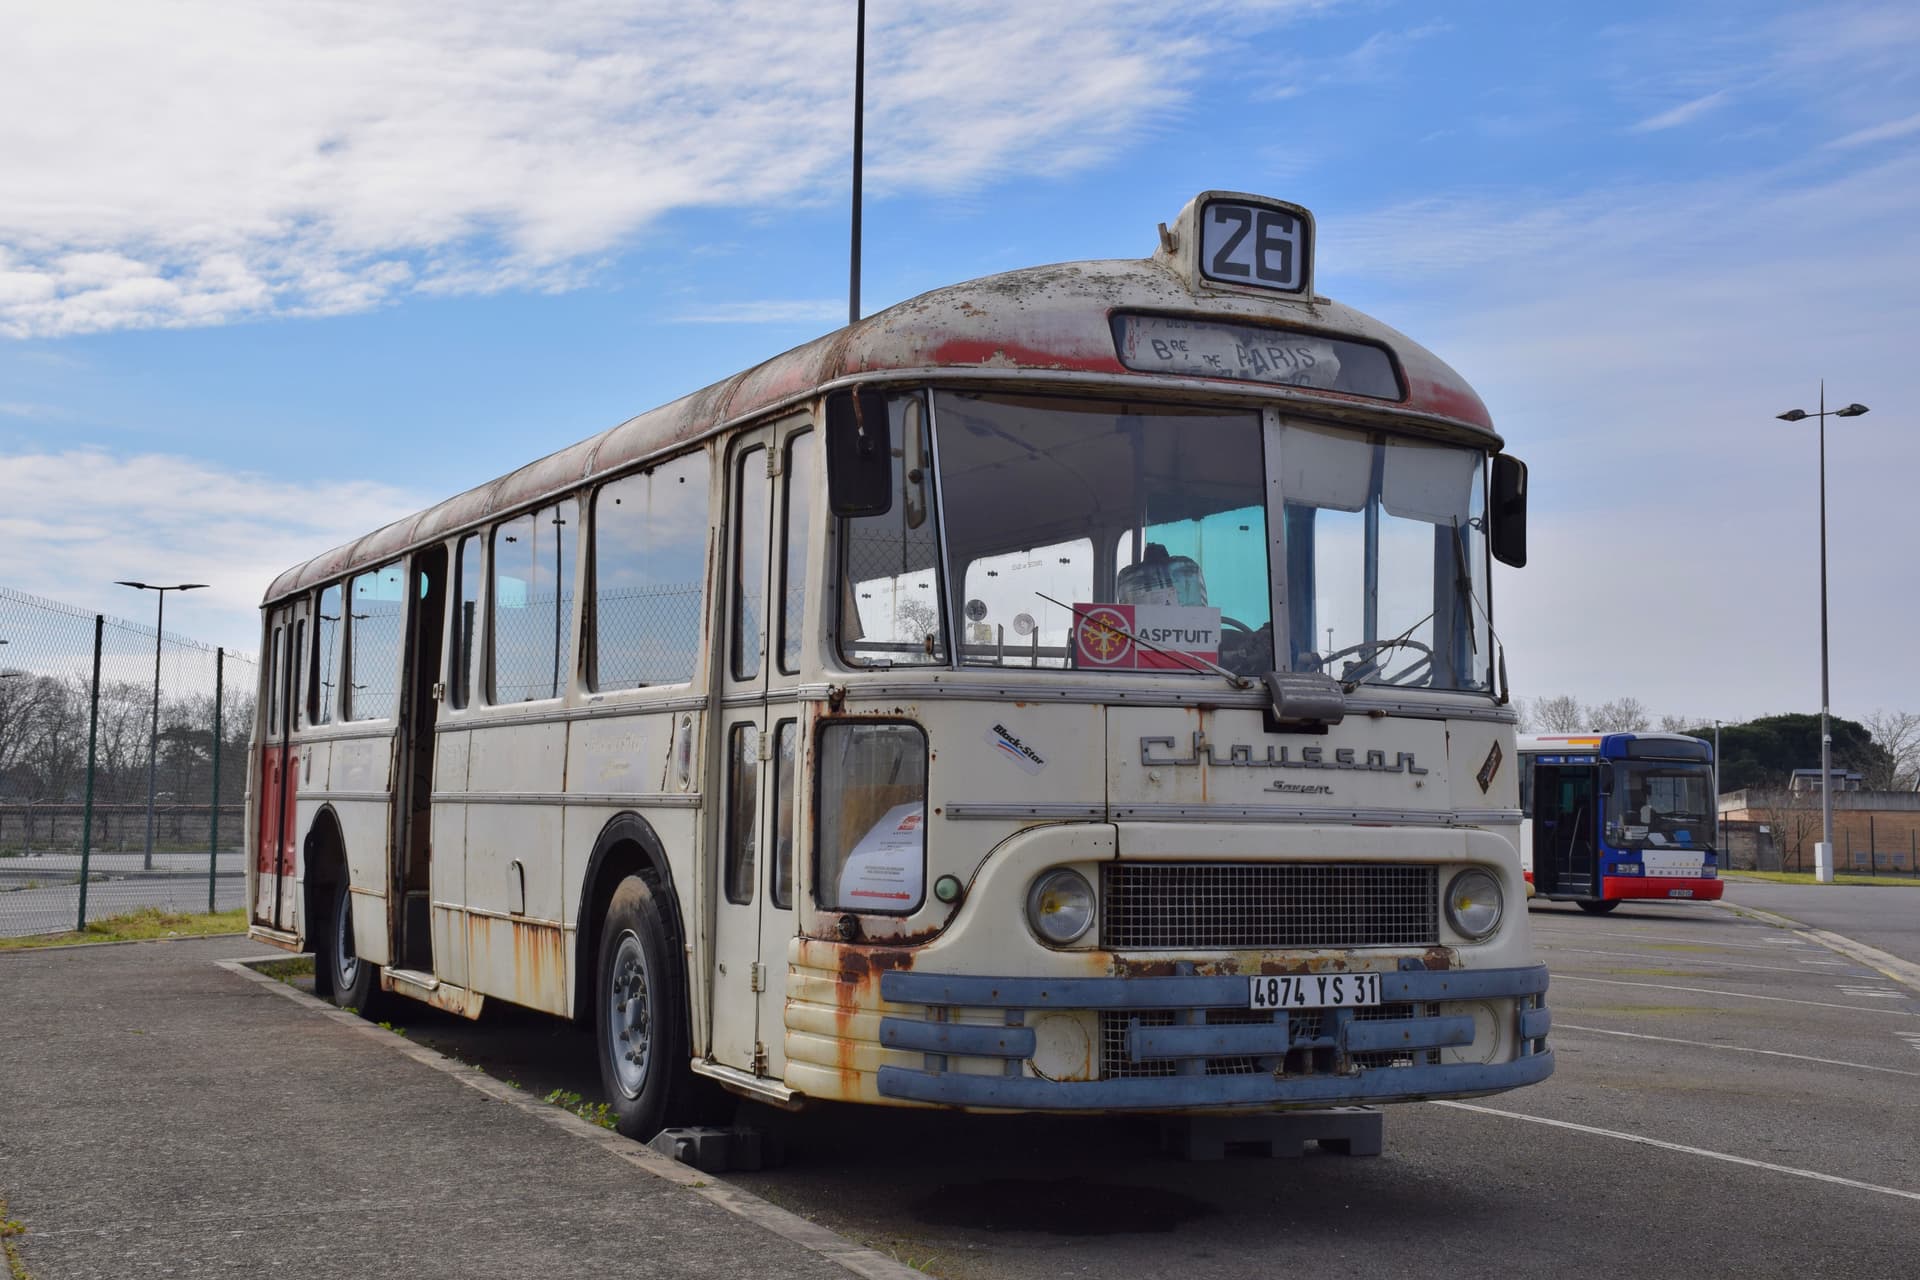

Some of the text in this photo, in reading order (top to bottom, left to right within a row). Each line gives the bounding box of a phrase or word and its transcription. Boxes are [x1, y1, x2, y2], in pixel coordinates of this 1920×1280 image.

[1212, 207, 1293, 283] 26
[1235, 342, 1316, 376] PARIS
[1138, 628, 1212, 644] ASPTUIT
[1140, 731, 1428, 775] Chausson
[1254, 975, 1376, 1006] 4874 YS 31
